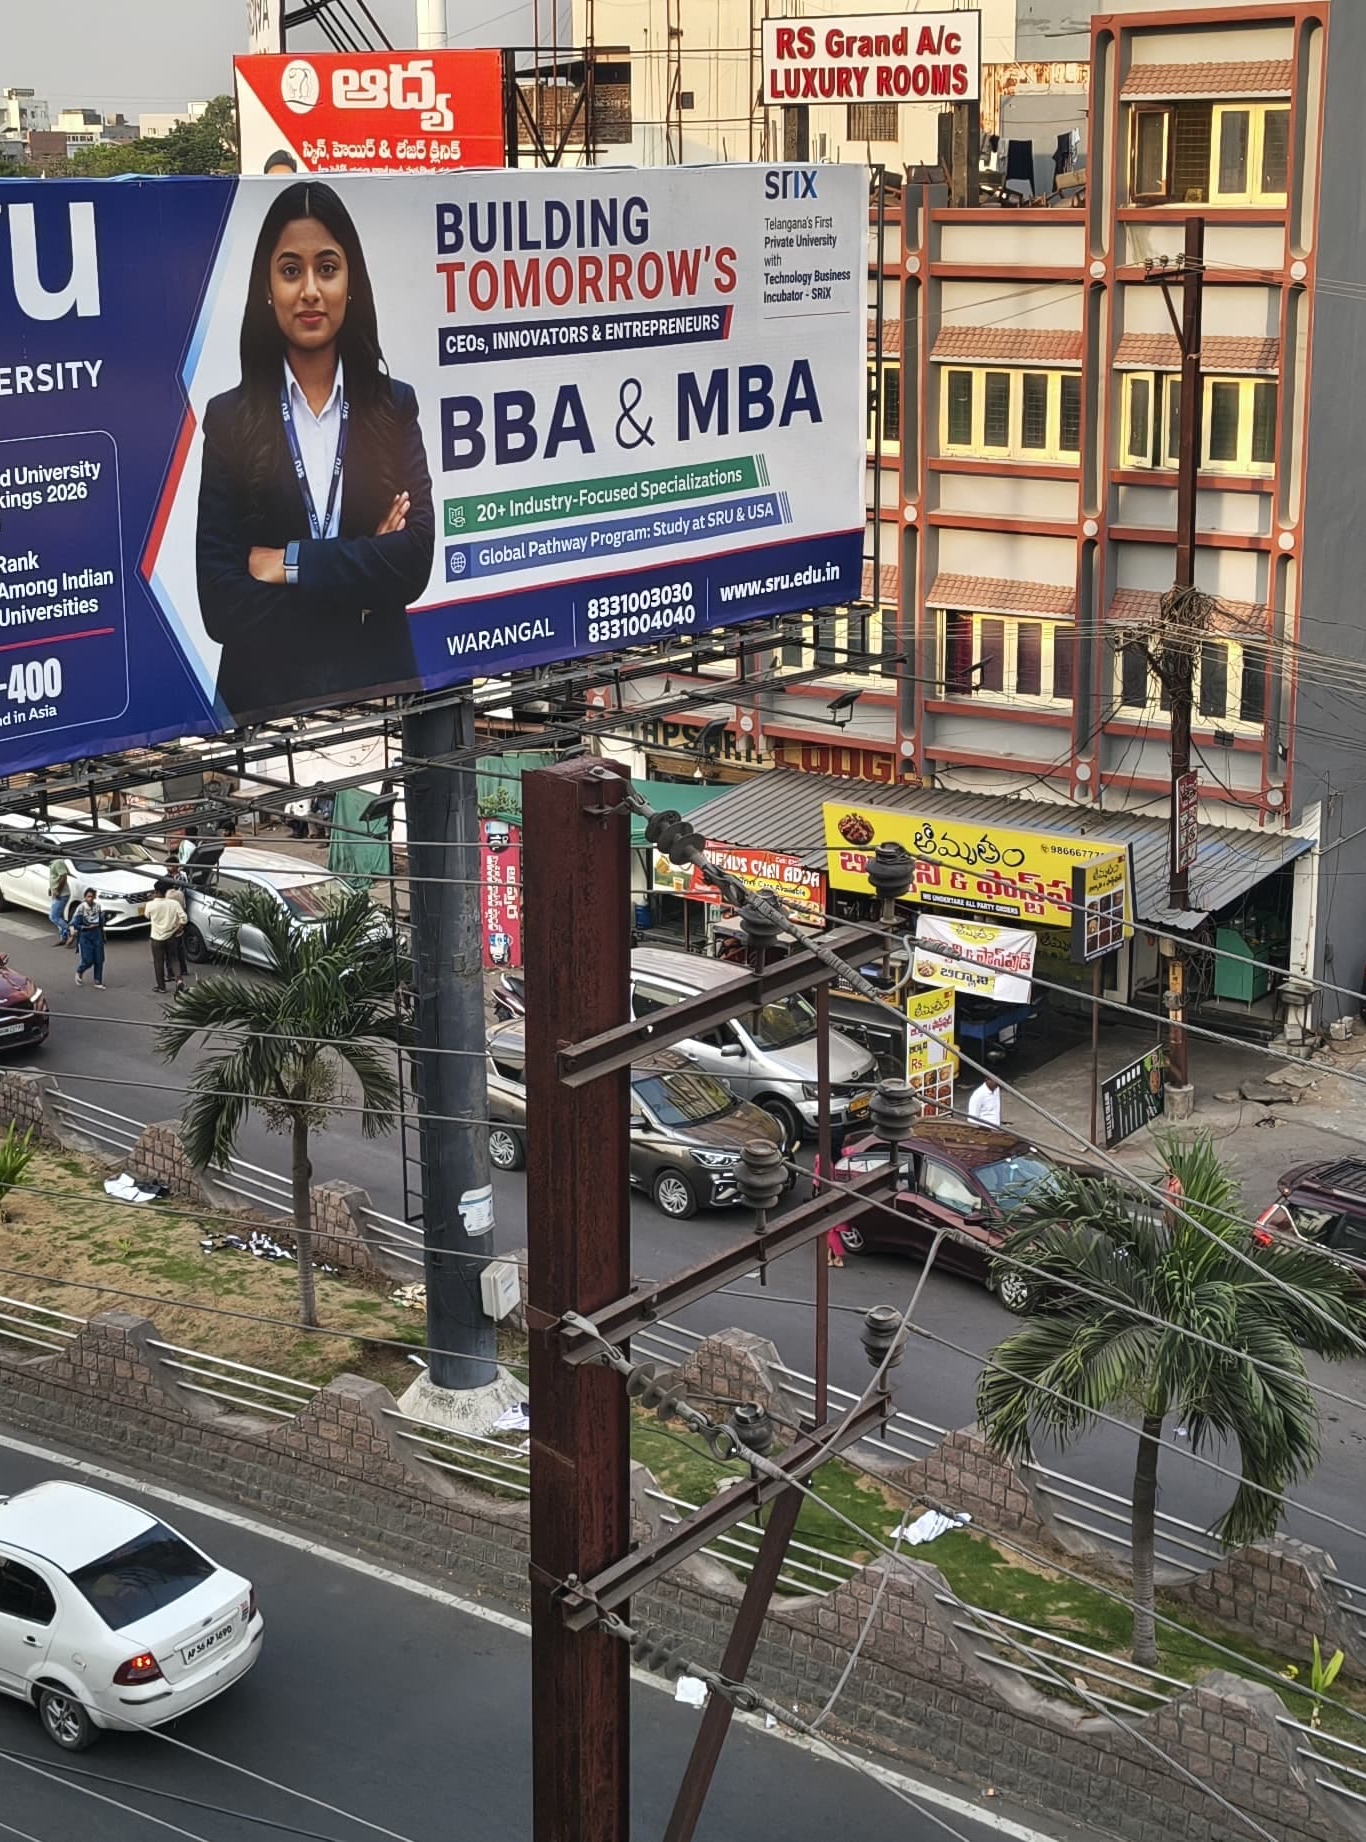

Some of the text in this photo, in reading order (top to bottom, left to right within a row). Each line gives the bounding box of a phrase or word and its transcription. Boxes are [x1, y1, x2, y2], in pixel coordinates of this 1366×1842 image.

[776, 24, 963, 59] RS Grand A/c
[331, 59, 455, 132] ఆద్య
[769, 63, 969, 99] LUXURY ROOMS
[378, 140, 393, 159] &
[435, 196, 650, 255] BUILDING
[813, 215, 833, 229] First
[764, 232, 837, 249] Private University
[764, 255, 782, 266] with
[764, 268, 851, 288] Technology Business
[763, 287, 805, 304] Incubator
[445, 313, 720, 355] CEOs, INNOVATORS & ENTREPRENEURS
[441, 357, 824, 473] BBA & MBA
[13, 459, 102, 490] University
[46, 481, 88, 505] 2026
[476, 466, 743, 523] 20+ Industry-Focused Specializations
[478, 501, 775, 567] Global Pathway Program: Study at SRU & USA
[61, 567, 114, 592] Indian
[720, 562, 841, 603] www.sru.edu.in
[587, 581, 694, 619] 8331003030
[446, 618, 556, 657] WARANGAL
[587, 605, 696, 643] 8331004040
[13, 711, 25, 725] in
[28, 703, 58, 722] Asia
[703, 849, 748, 874] RIENDS
[750, 858, 781, 881] CHAI
[783, 866, 820, 888] ADDA
[949, 871, 967, 890] &
[965, 900, 976, 908] ALL
[977, 902, 995, 911] PARTY
[187, 1648, 196, 1660] AP
